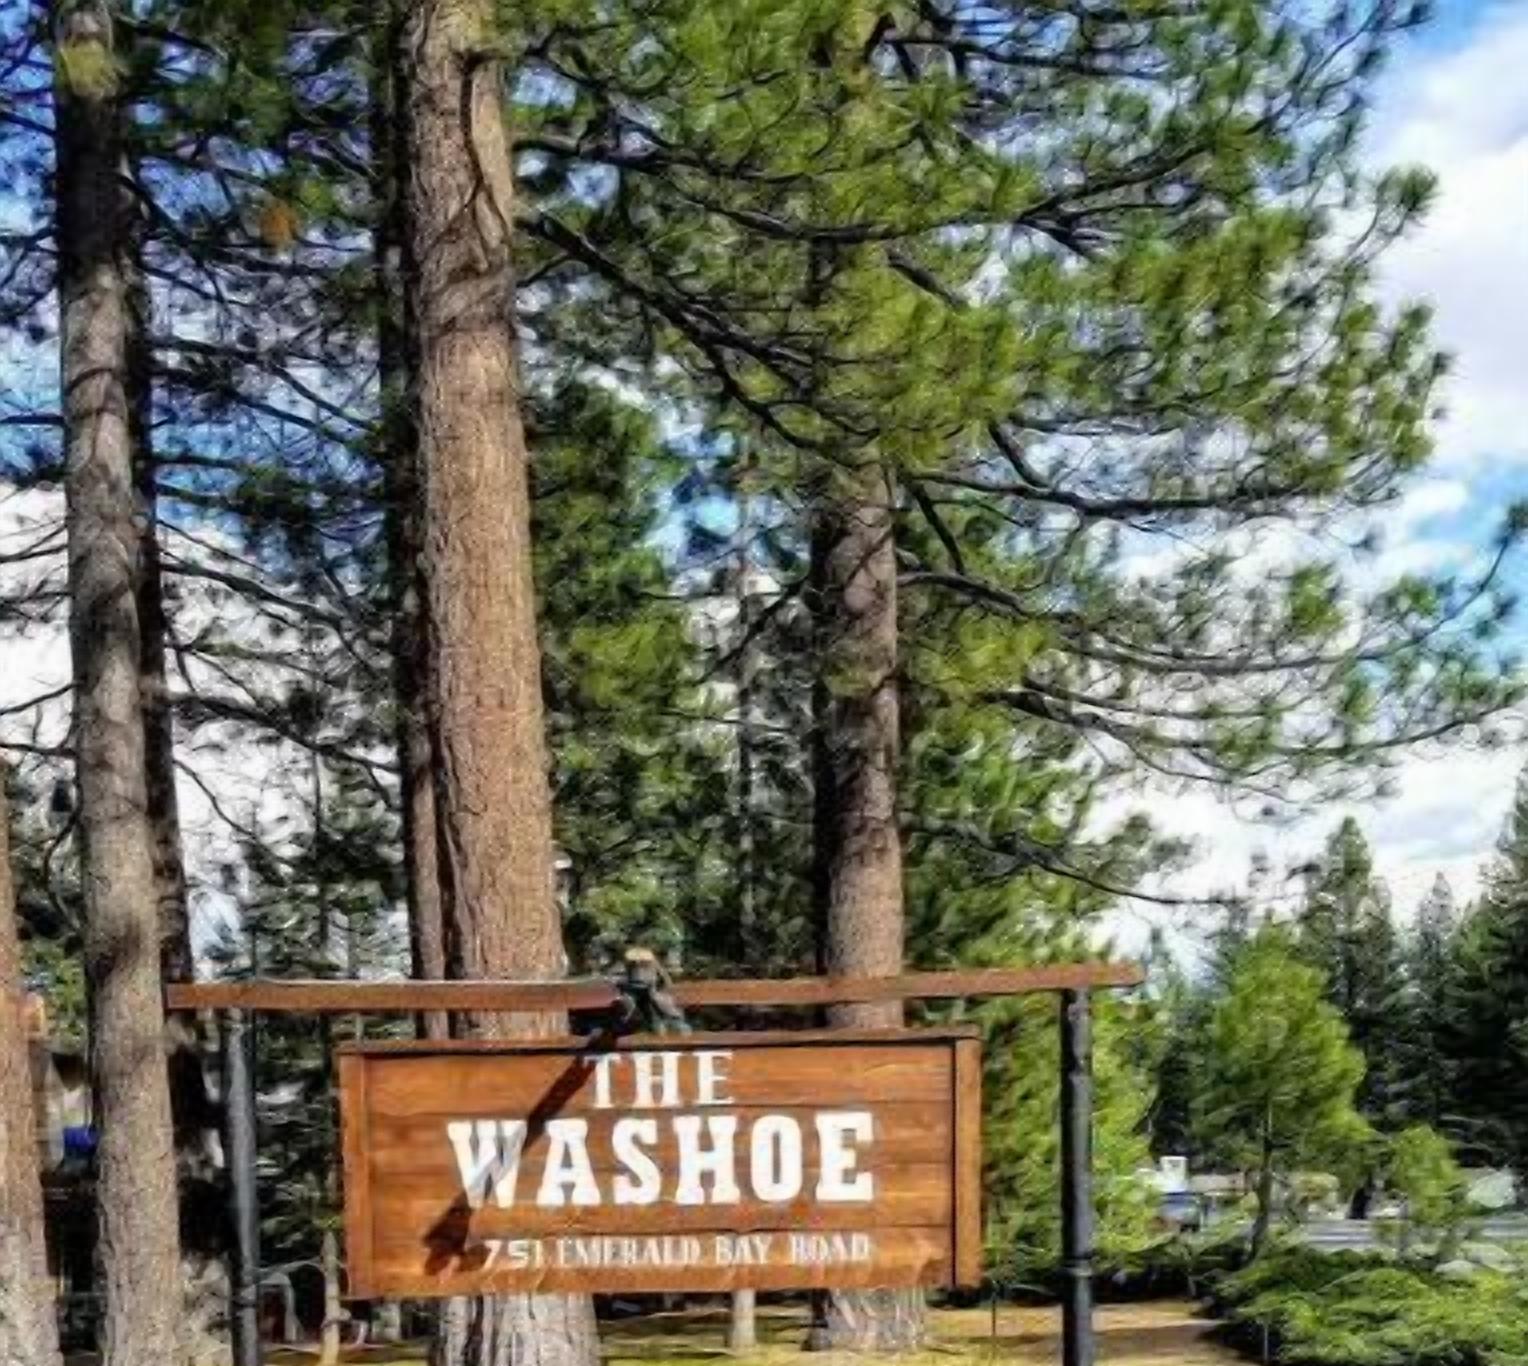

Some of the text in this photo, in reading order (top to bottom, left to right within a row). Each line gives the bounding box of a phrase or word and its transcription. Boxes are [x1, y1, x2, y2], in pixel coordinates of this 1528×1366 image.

[584, 1051, 734, 1108] THE
[447, 1112, 874, 1208] WASHOE
[481, 1232, 869, 1270] 751 EMERALD BAY ROAD
